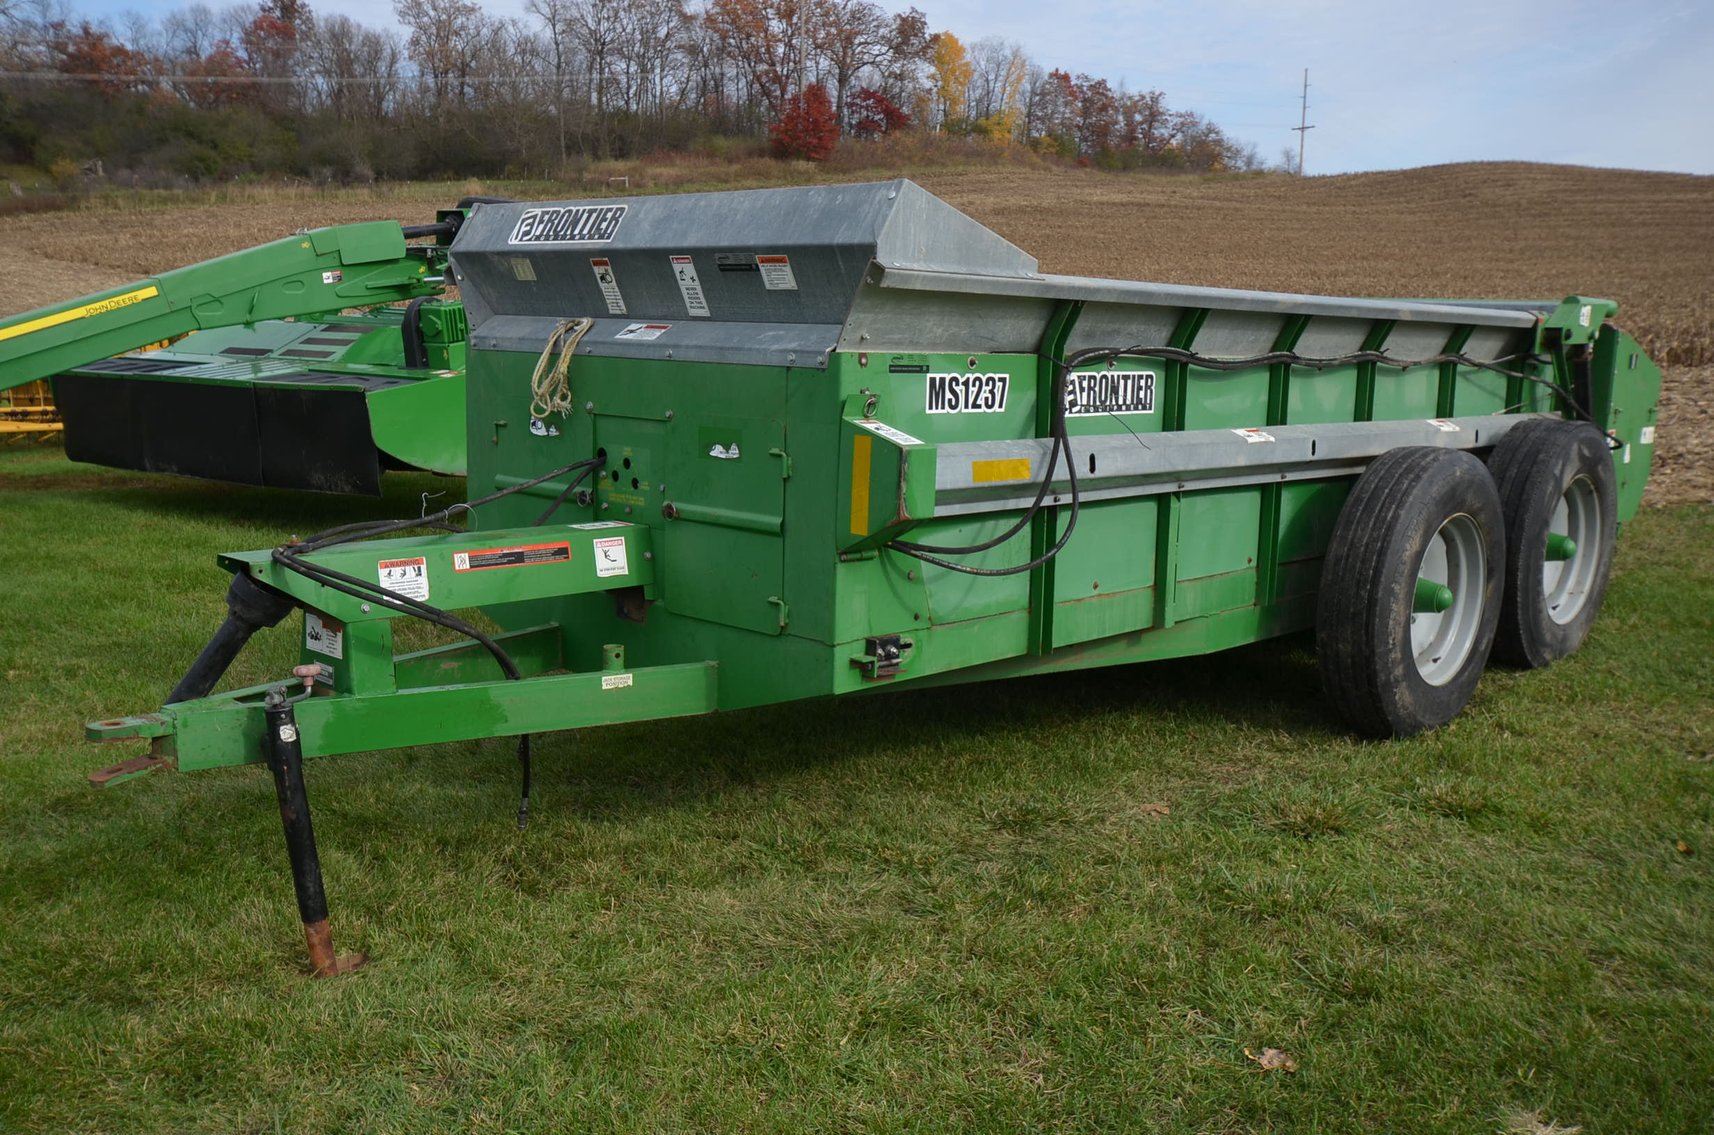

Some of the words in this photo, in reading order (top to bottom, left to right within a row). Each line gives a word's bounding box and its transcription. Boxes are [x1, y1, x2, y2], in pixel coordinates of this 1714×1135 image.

[535, 207, 626, 236] FRONTIER
[84, 304, 108, 316] JOHN
[108, 295, 139, 309] DEERE
[928, 376, 1007, 410] MS1237
[1077, 374, 1154, 405] FRONTIER
[390, 559, 420, 568] WARNING
